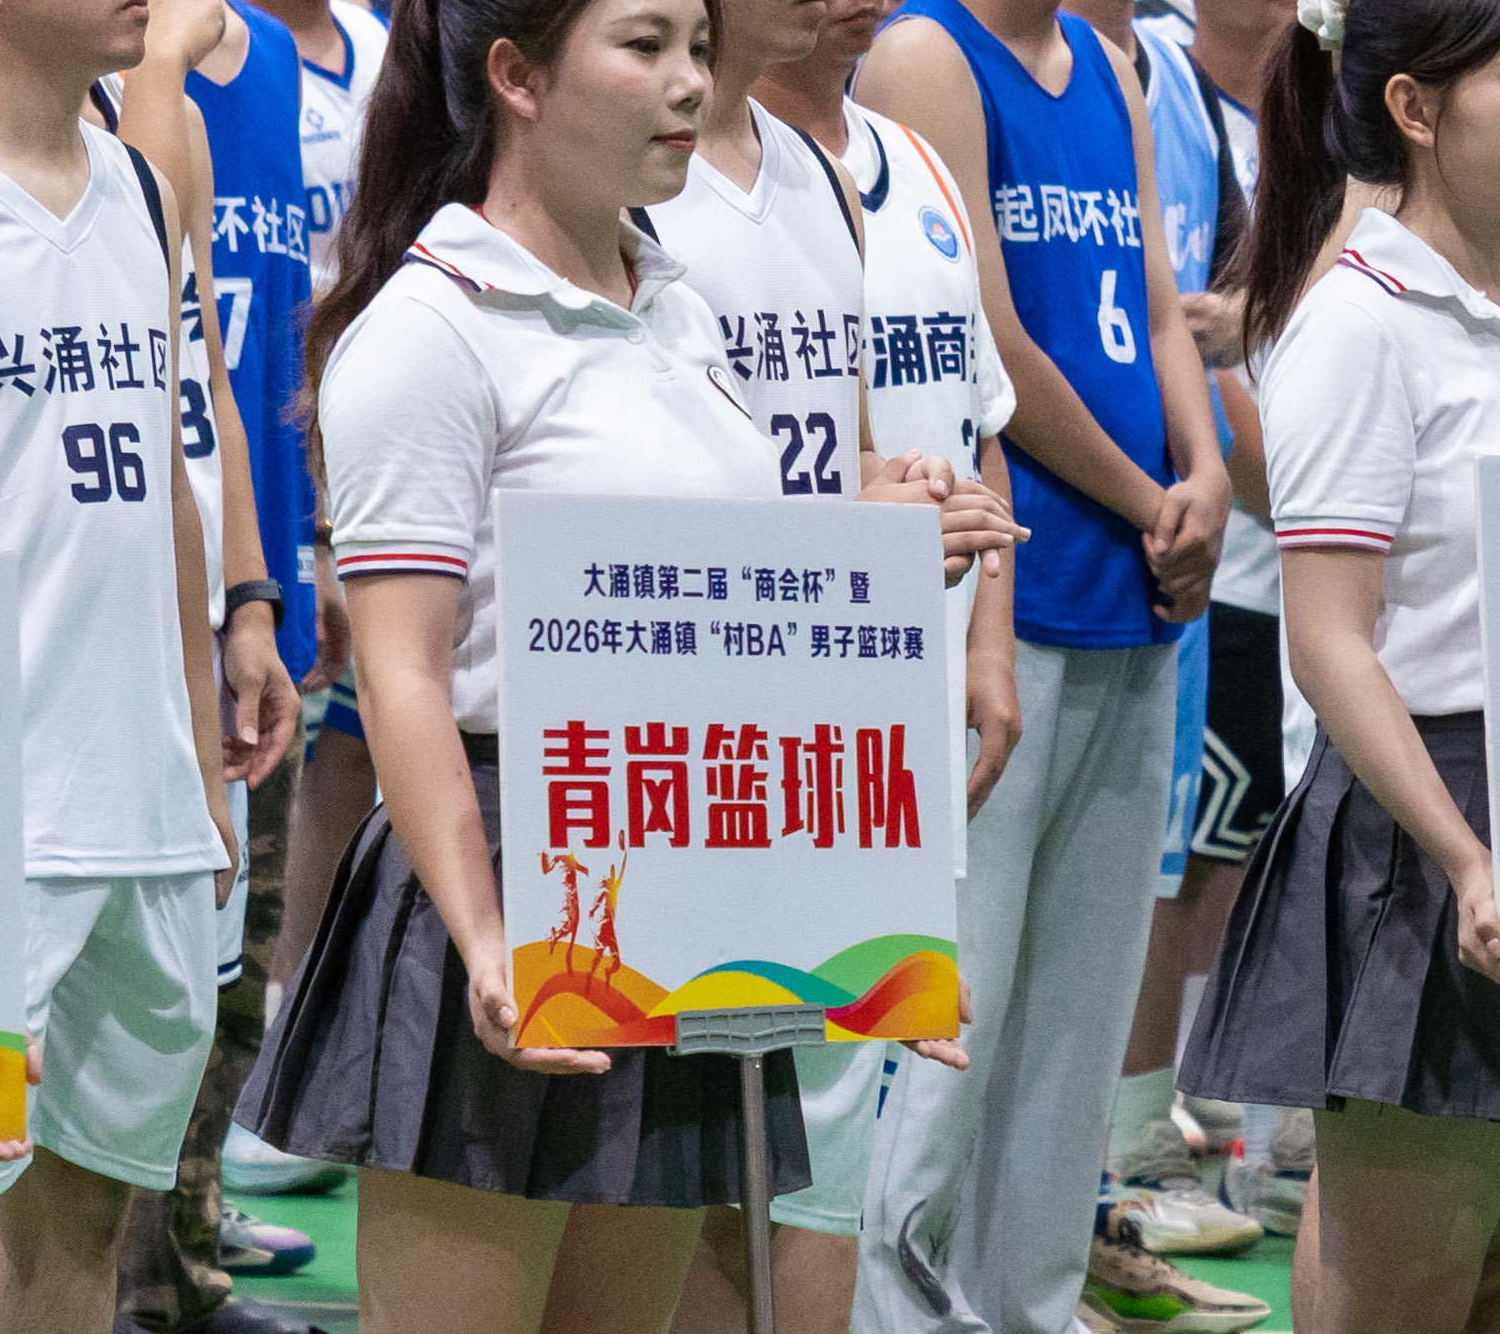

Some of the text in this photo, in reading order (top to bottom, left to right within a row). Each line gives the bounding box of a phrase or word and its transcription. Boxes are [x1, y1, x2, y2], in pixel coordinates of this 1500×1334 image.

[862, 311, 978, 390] 涌商
[1097, 269, 1137, 364] 6
[61, 422, 147, 504] 96
[770, 412, 842, 496] 22
[541, 720, 922, 850] 青岗篮球队
